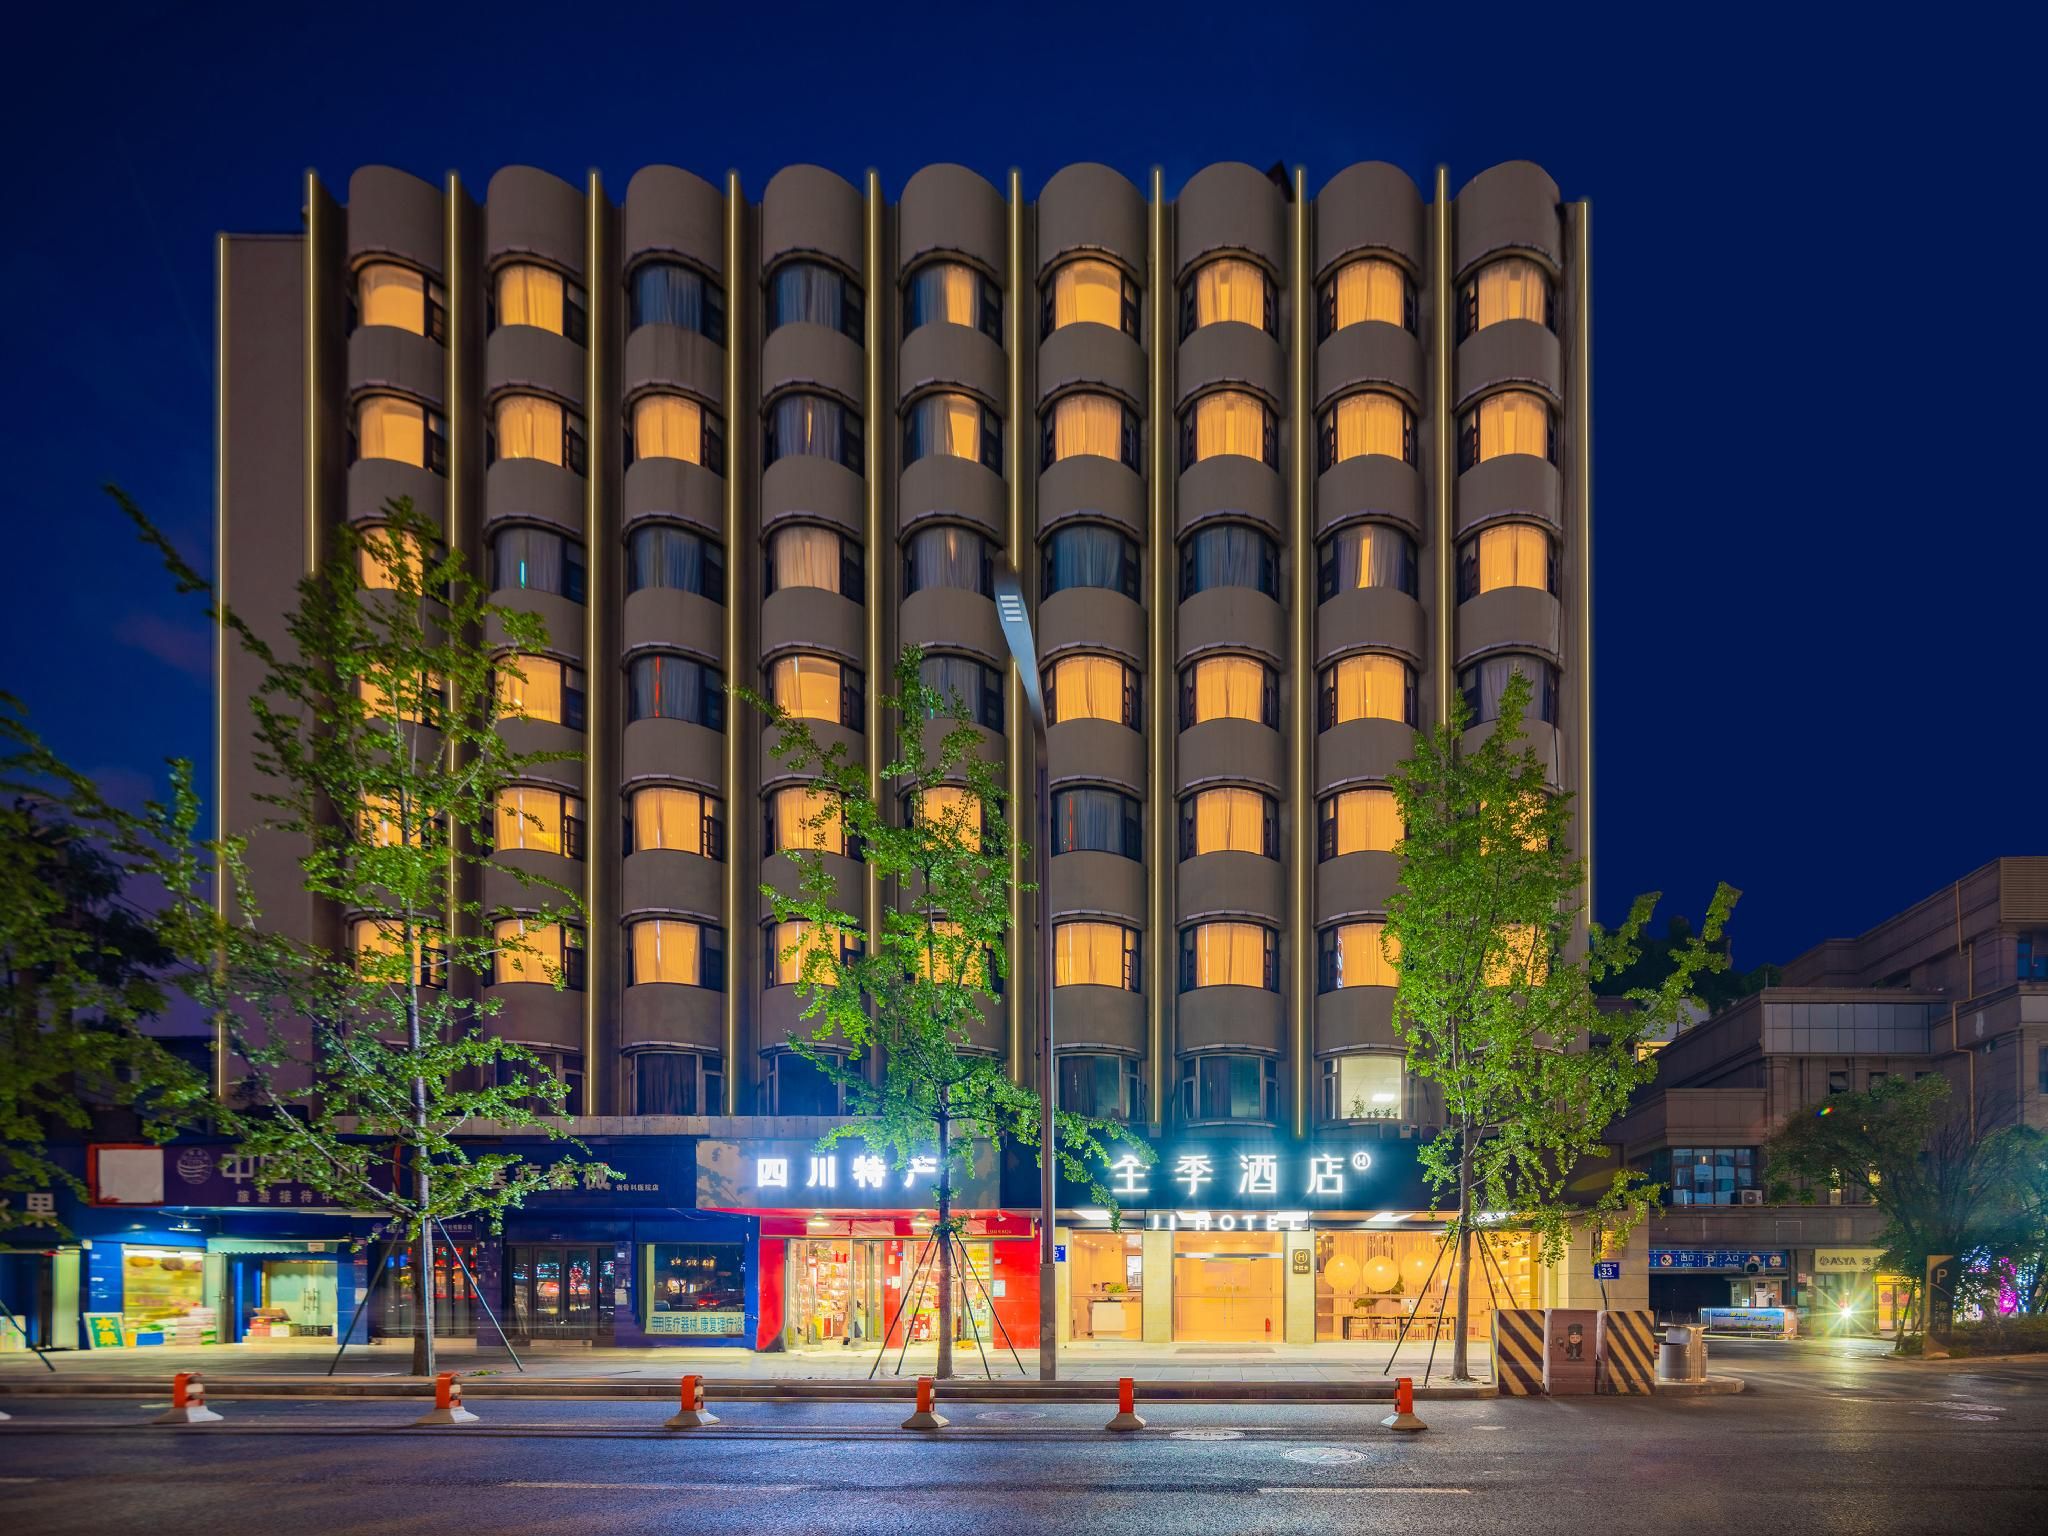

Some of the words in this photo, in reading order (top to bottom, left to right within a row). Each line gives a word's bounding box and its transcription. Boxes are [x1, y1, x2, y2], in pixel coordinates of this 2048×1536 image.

[757, 1155, 937, 1188] 四川特产
[1112, 1154, 1345, 1196] 全季酒店
[236, 1190, 335, 1203] 旅游接待中
[1153, 1214, 1176, 1231] JI
[1195, 1214, 1303, 1231] HOTEL
[1680, 1253, 1695, 1262] 出口
[1725, 1254, 1739, 1262] 入口
[1601, 1267, 1613, 1276] 33
